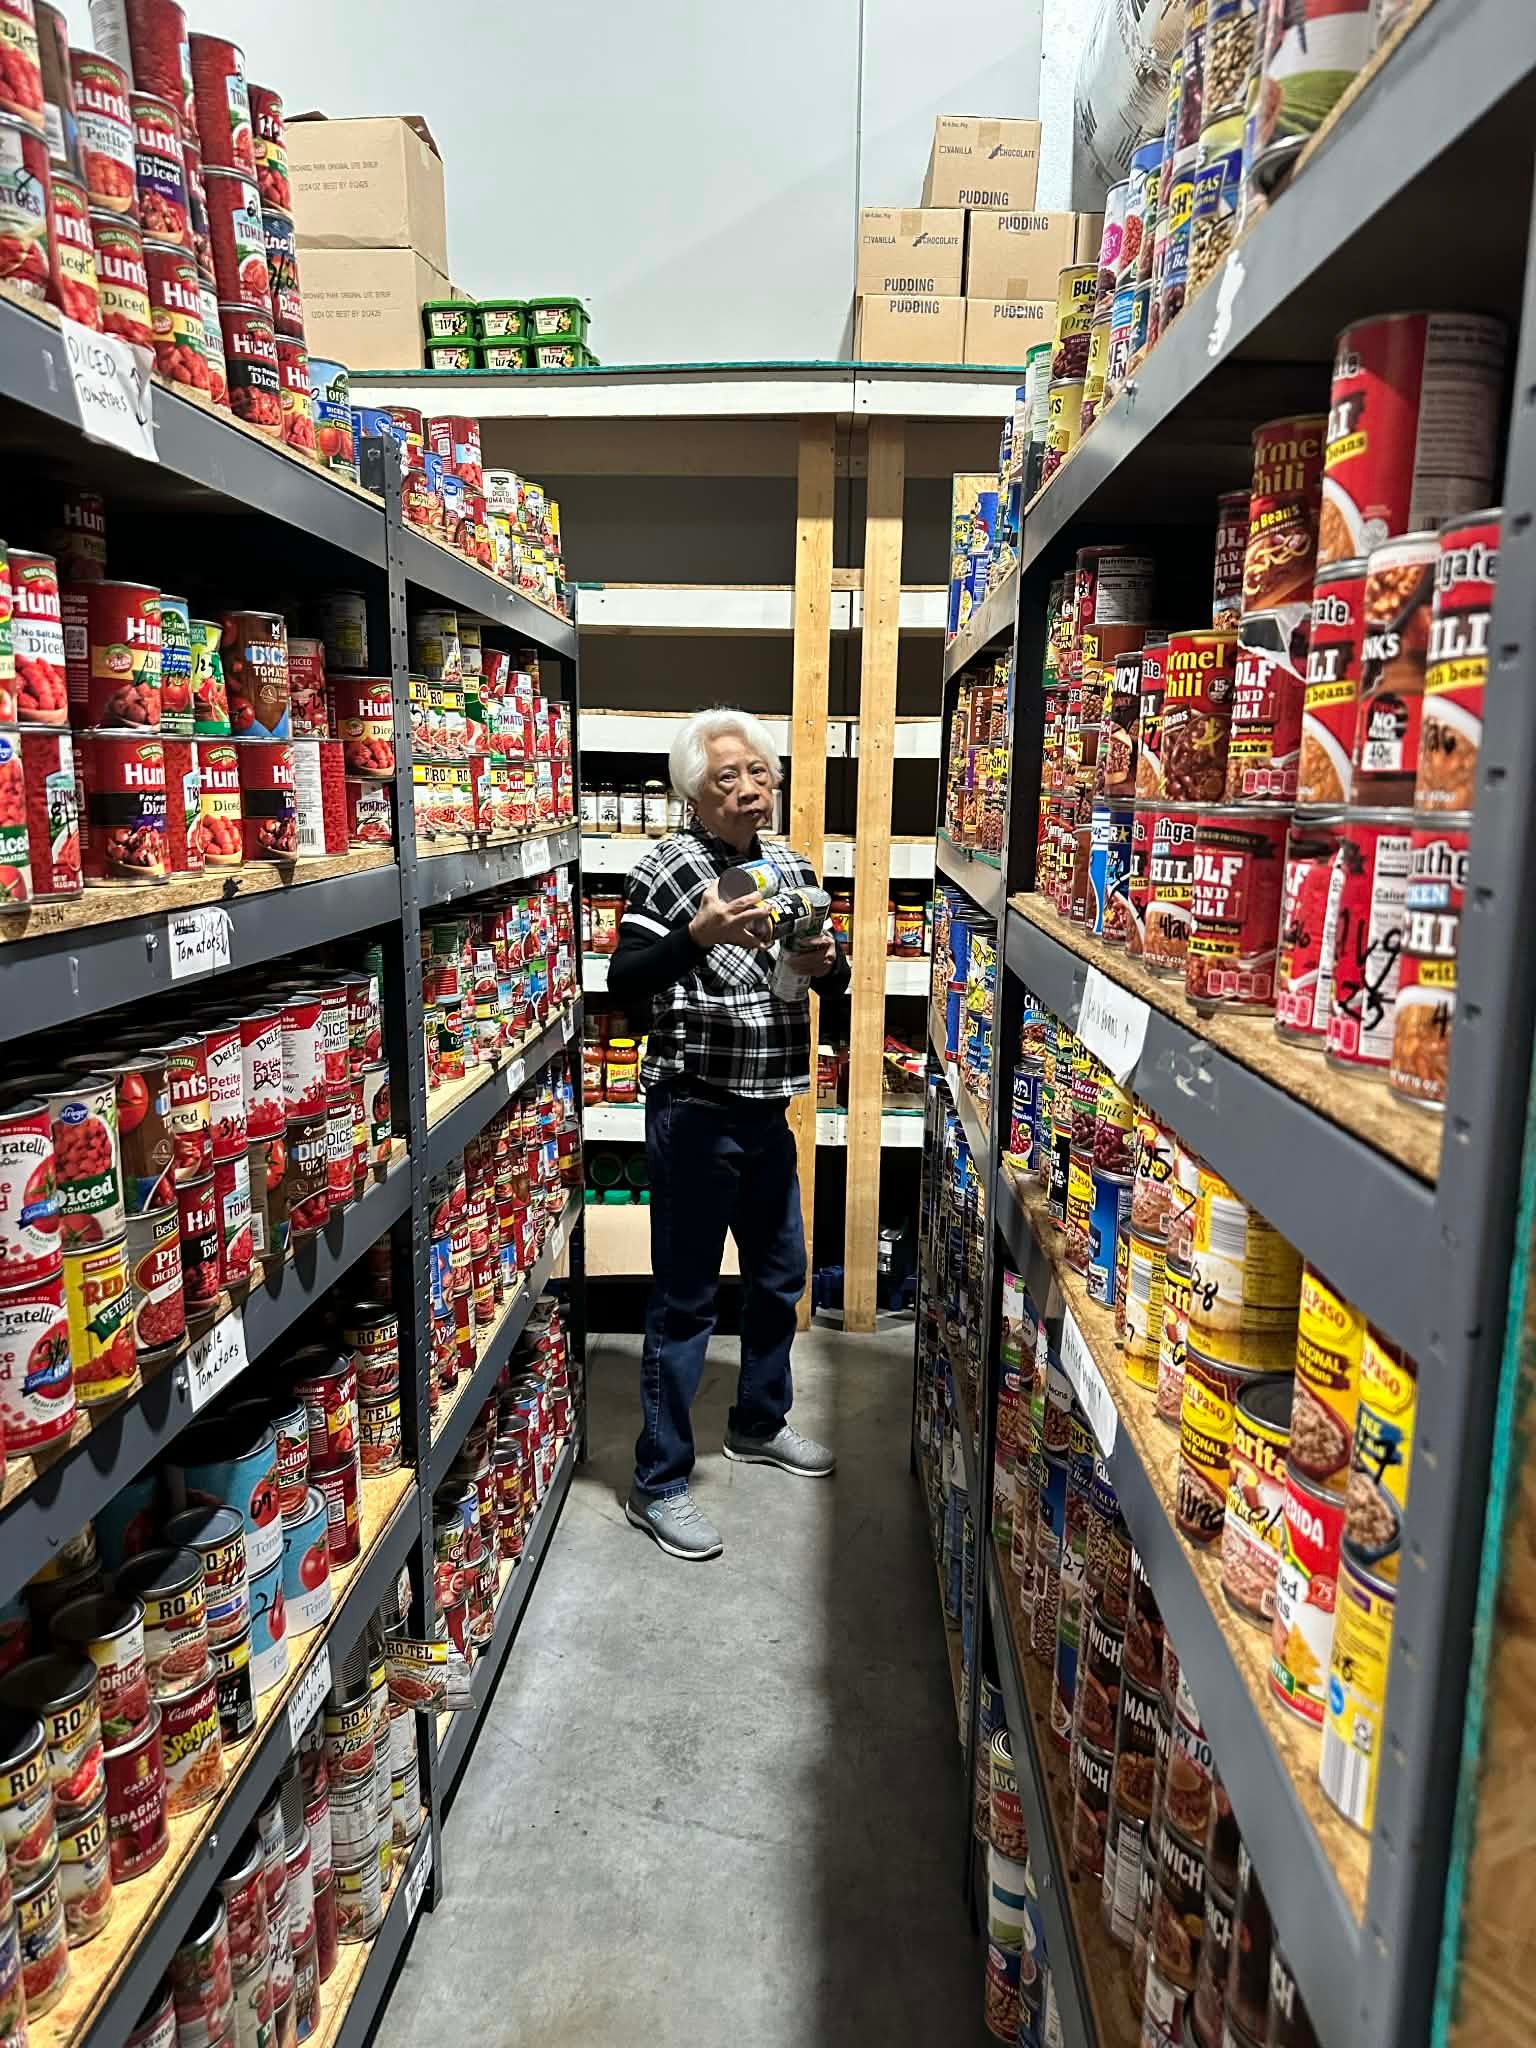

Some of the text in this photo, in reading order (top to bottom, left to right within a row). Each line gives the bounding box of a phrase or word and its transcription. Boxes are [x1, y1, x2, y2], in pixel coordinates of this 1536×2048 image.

[945, 146, 1035, 159] VANILLA CHOCOLATE
[140, 162, 180, 185] Diced
[959, 190, 1009, 206] PUDDING
[998, 216, 1049, 231] PUDDING
[871, 236, 896, 245] VANILLA
[884, 278, 934, 292] PUDDING
[103, 292, 145, 316] Diced
[890, 300, 940, 314] PUDDING
[993, 304, 1044, 320] PUDDING
[68, 335, 116, 377] DICED
[1313, 684, 1354, 702] beans
[209, 1073, 241, 1090] Petite
